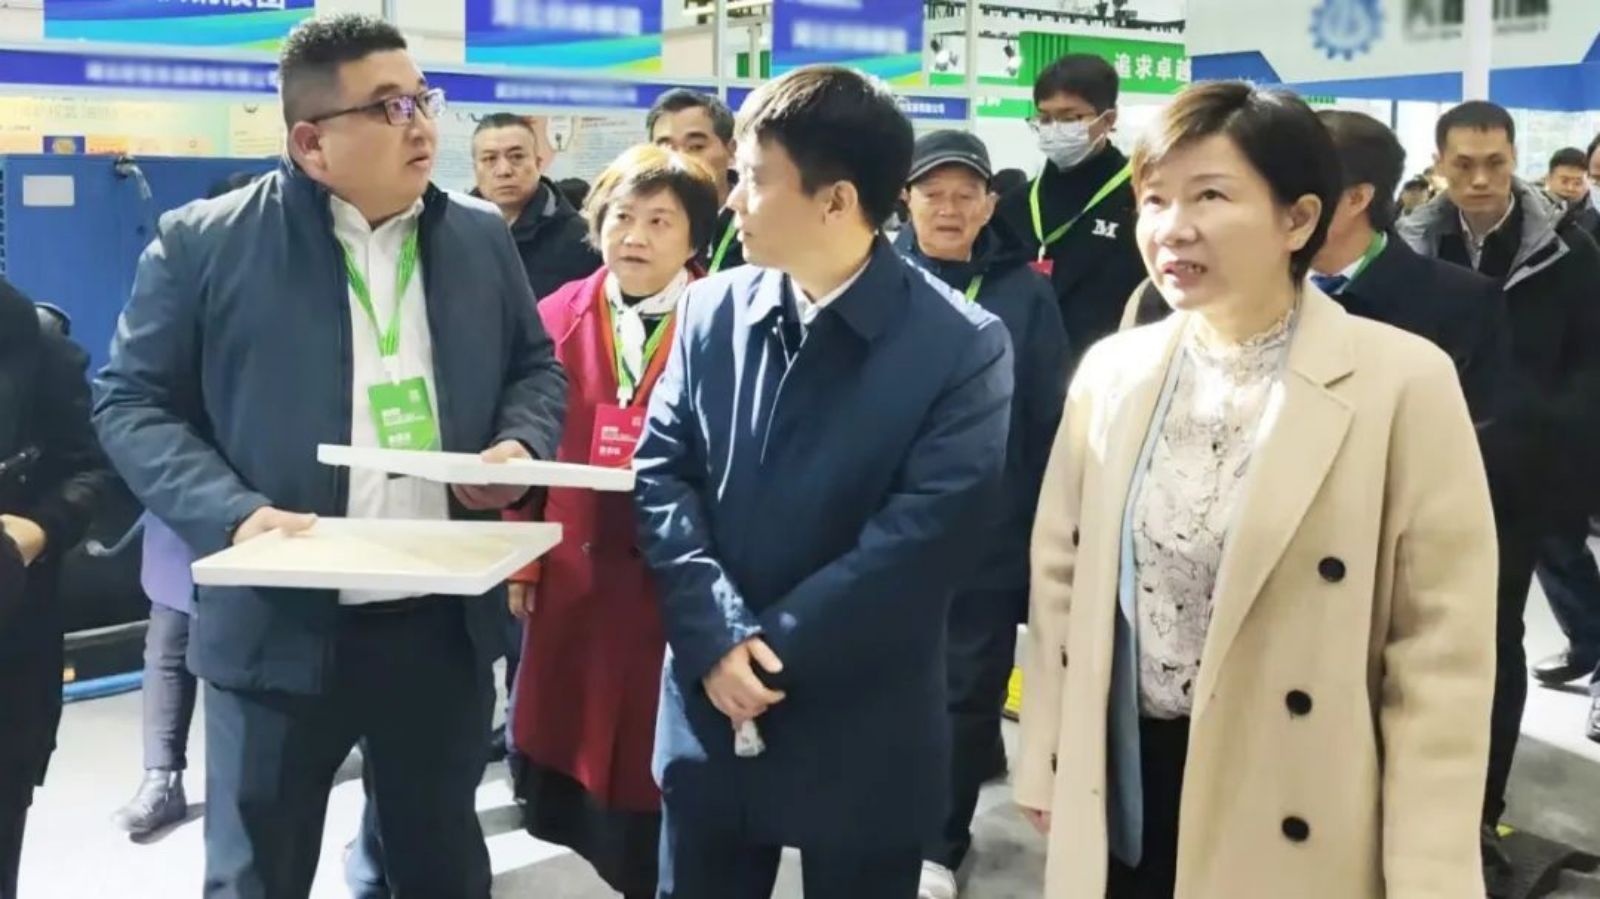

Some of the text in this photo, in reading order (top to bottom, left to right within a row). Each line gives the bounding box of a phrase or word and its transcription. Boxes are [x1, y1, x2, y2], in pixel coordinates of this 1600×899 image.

[1114, 52, 1192, 82] 追求卓越
[1092, 218, 1119, 238] M
